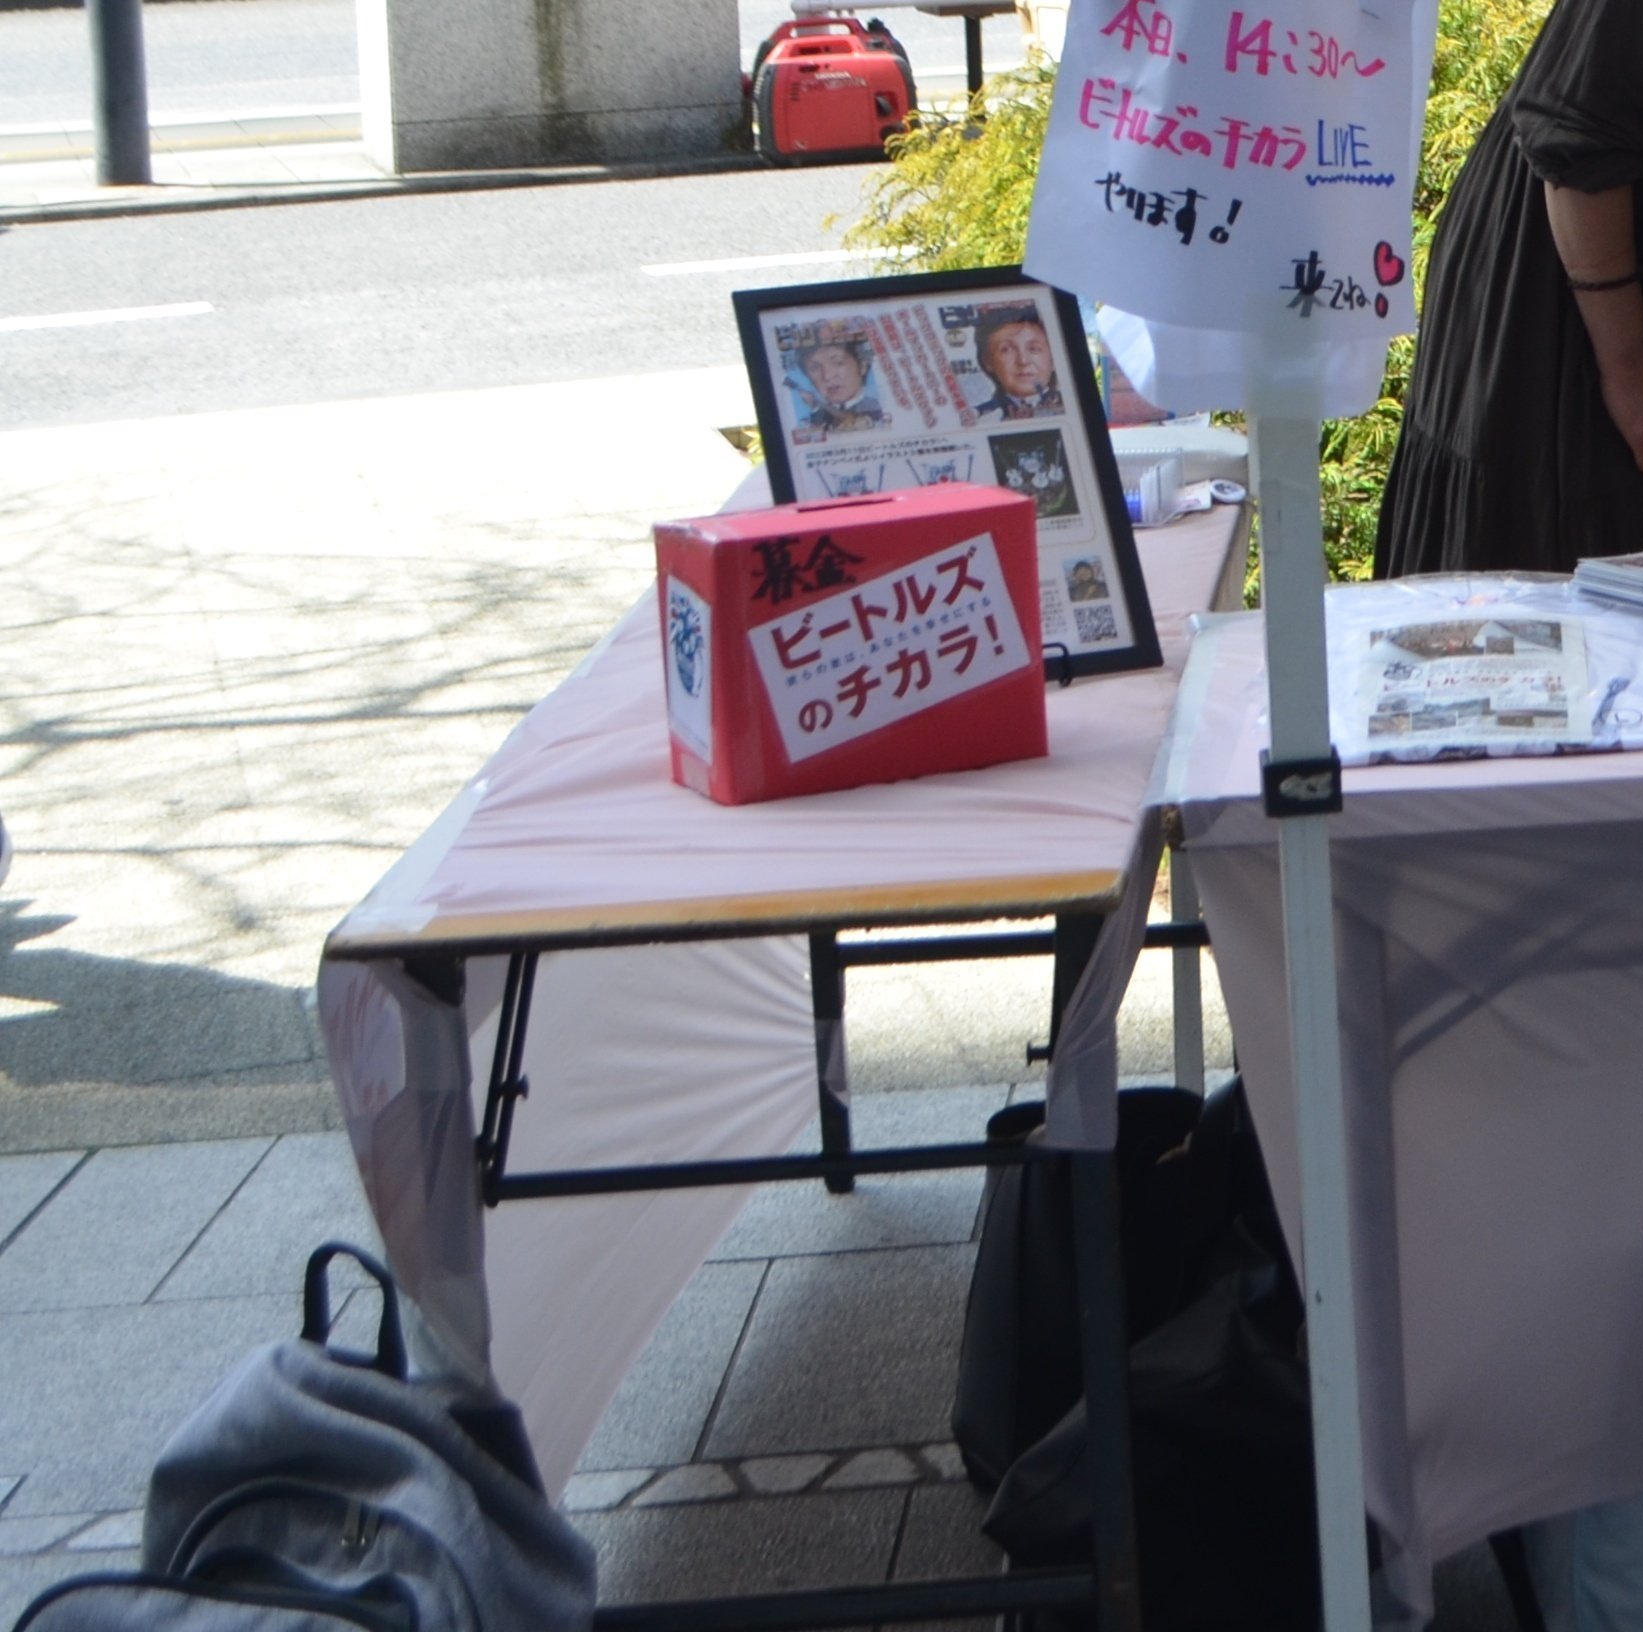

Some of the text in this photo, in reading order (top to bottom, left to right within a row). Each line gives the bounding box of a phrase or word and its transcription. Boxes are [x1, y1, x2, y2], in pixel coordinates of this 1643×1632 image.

[752, 534, 867, 605] 募金
[771, 545, 985, 670] ビートルズ
[798, 614, 1004, 734] のチカラ!
